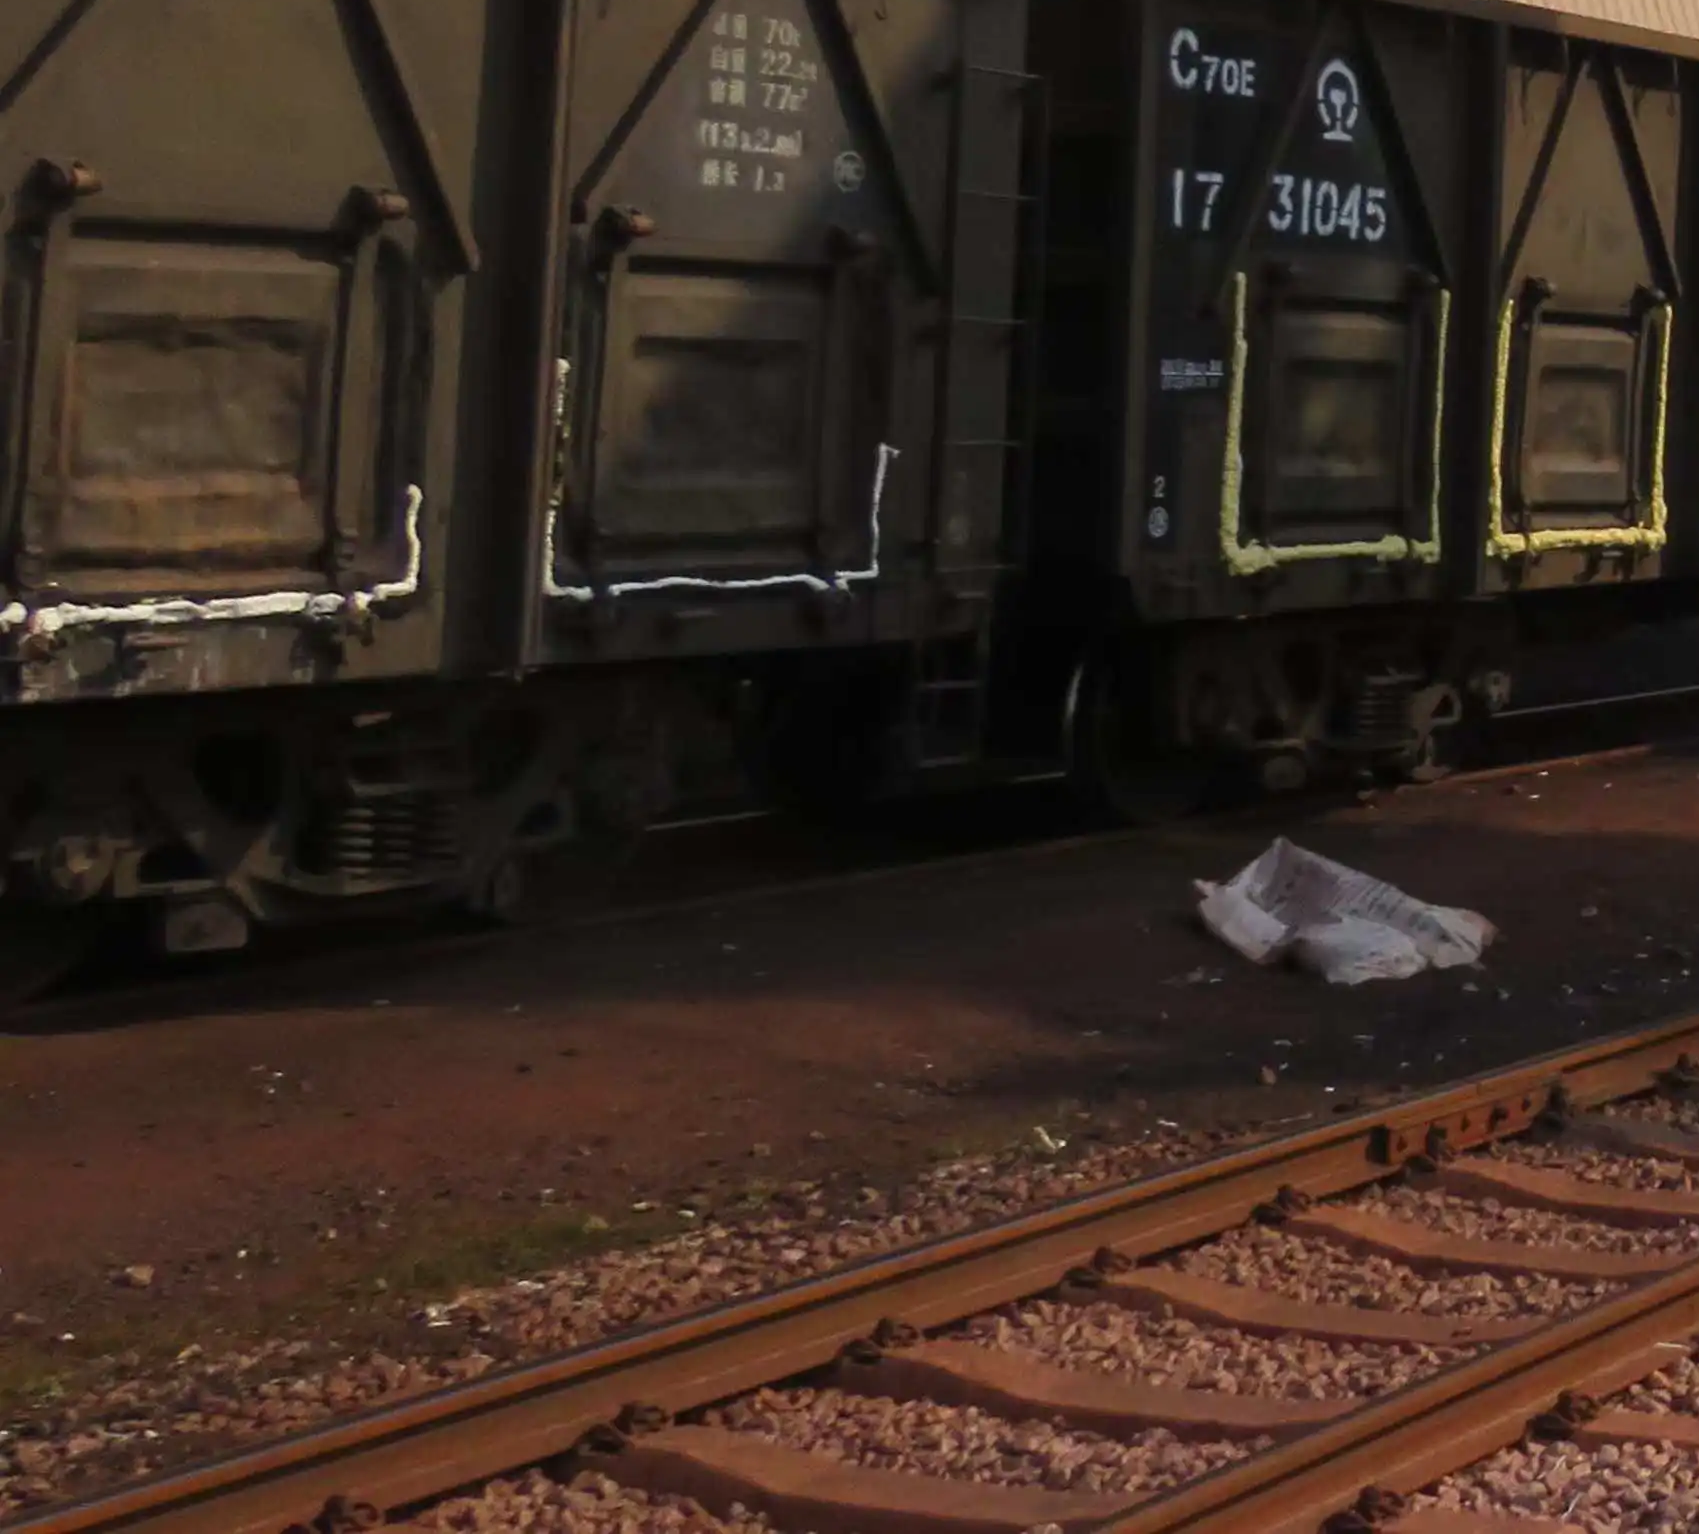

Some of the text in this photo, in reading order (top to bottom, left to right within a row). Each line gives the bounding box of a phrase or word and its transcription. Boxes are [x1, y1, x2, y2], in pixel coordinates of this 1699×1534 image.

[1169, 28, 1256, 98] C70E
[1171, 167, 1387, 242] 17 31045
[1153, 475, 1166, 498] 2
